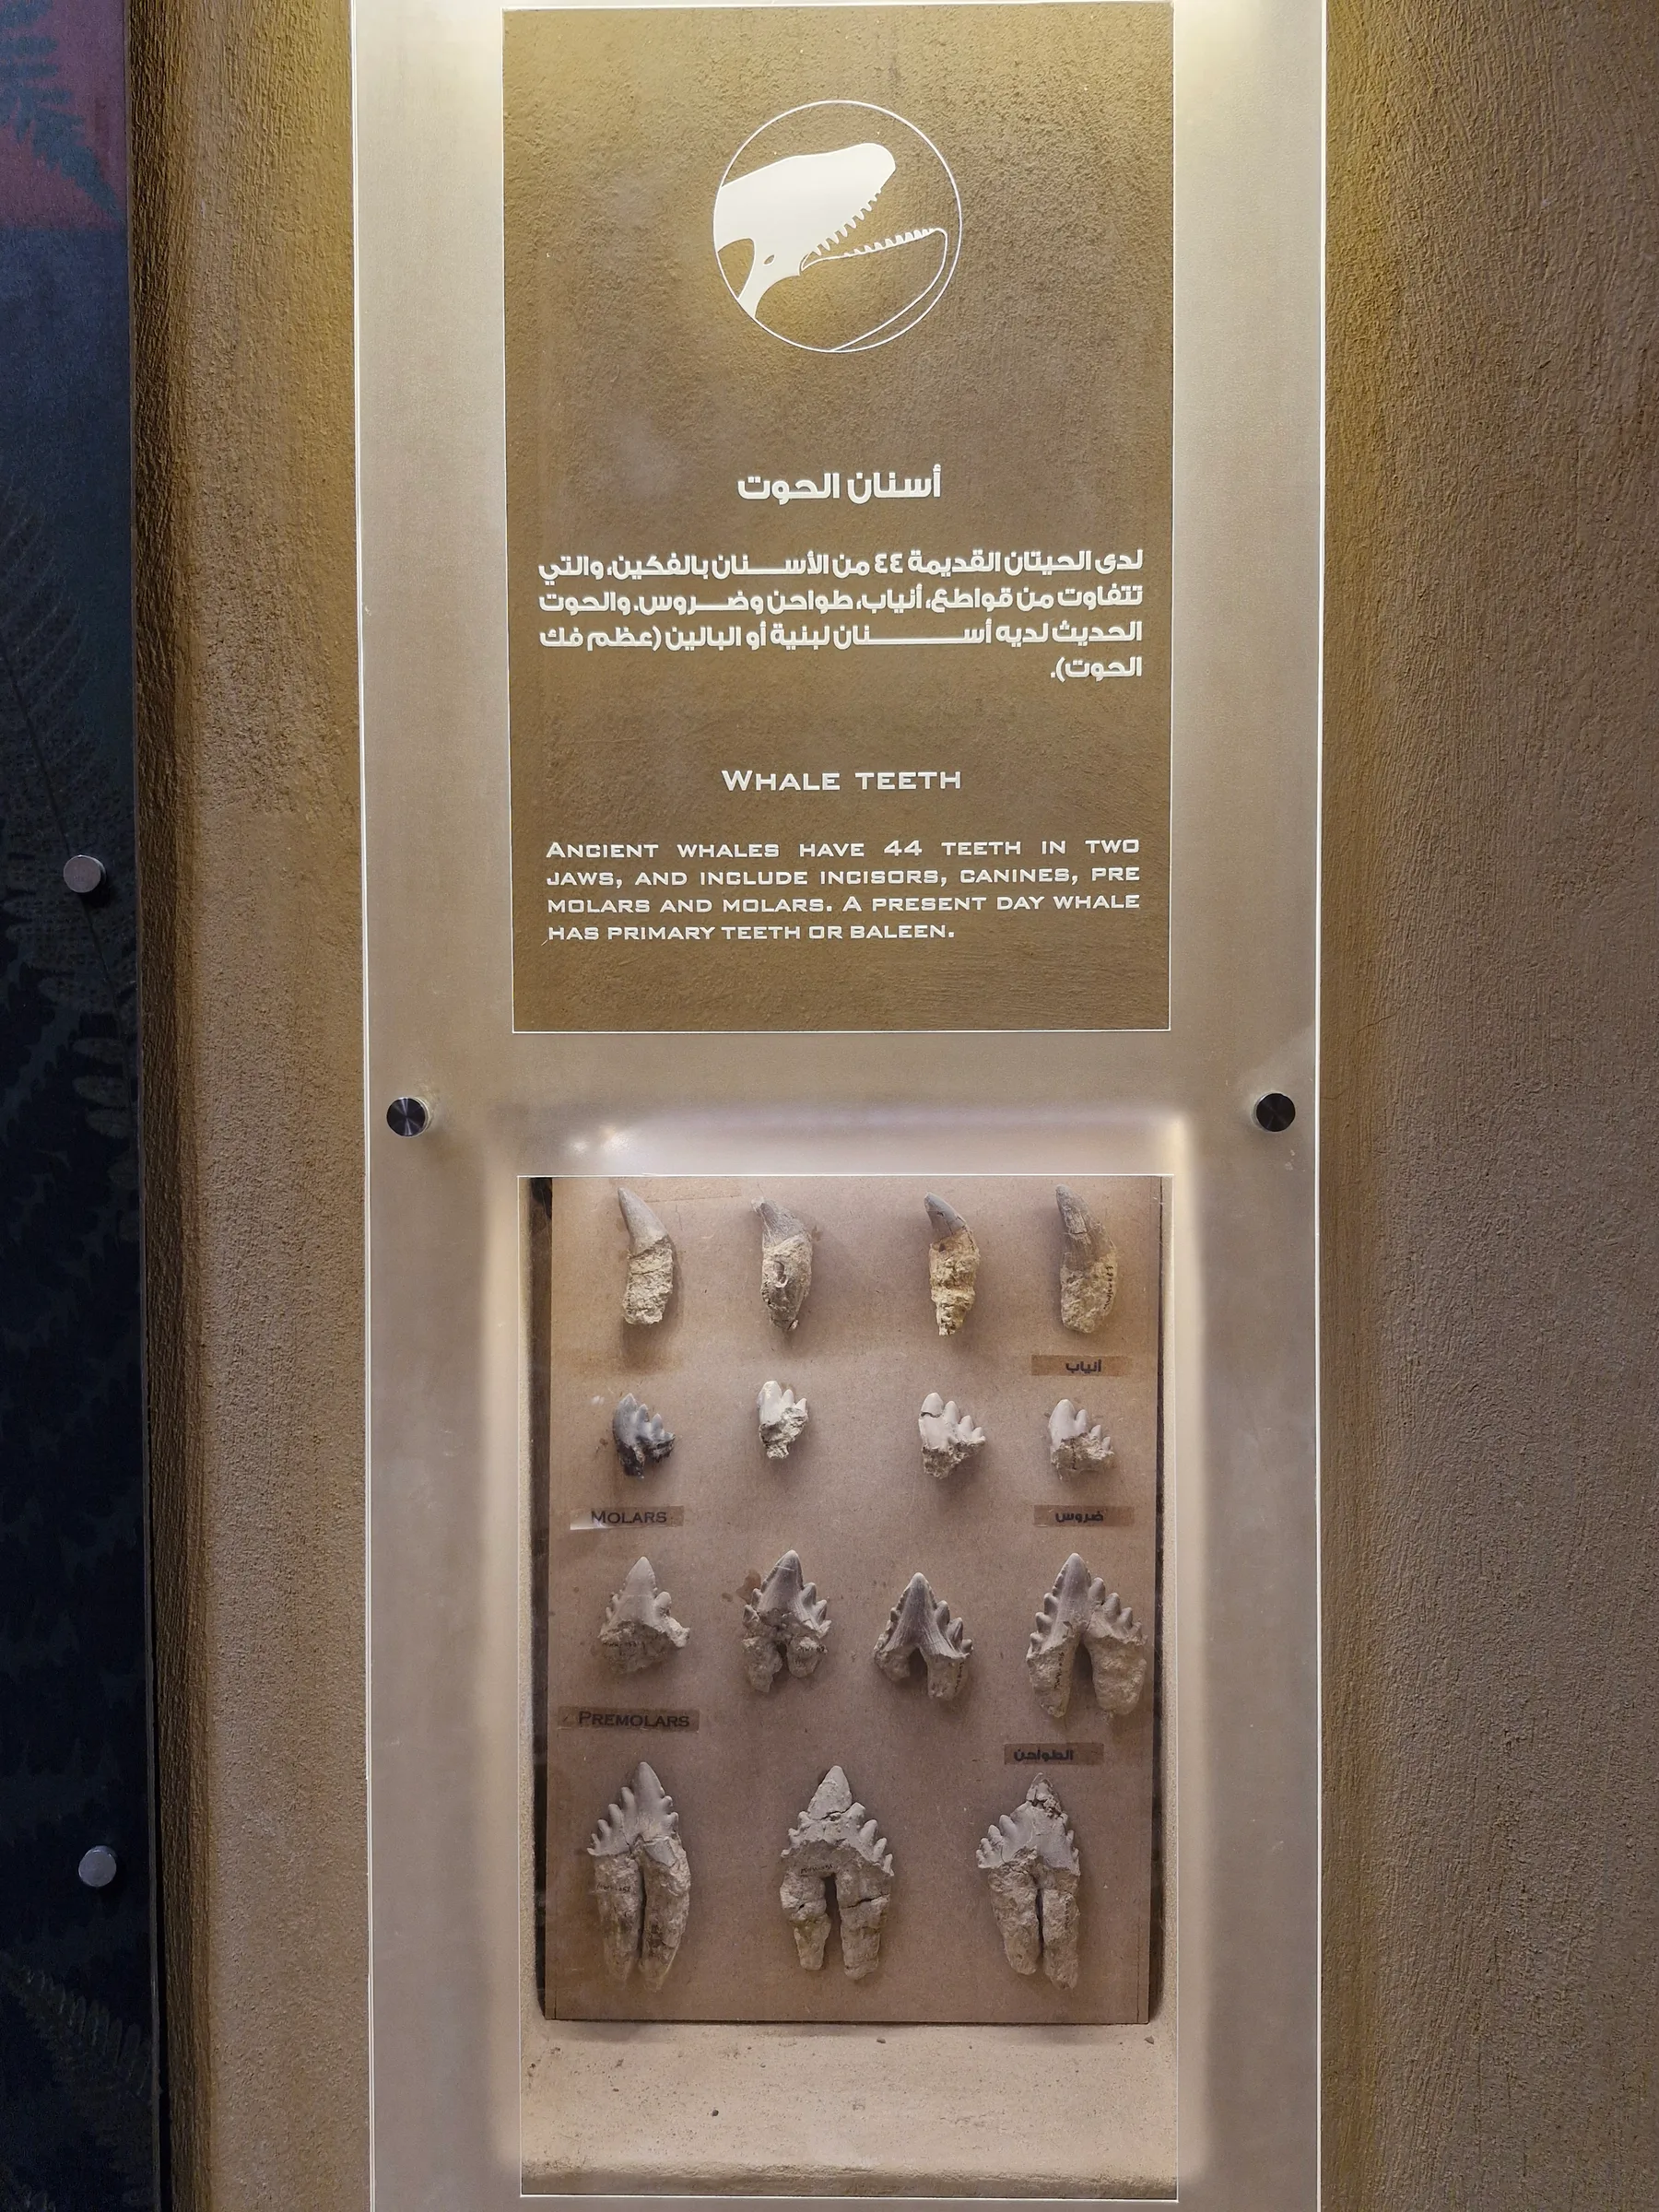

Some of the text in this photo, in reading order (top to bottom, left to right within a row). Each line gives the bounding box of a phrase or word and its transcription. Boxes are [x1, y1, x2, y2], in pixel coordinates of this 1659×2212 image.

[738, 464, 942, 505] أسنان الحوت
[538, 554, 606, 584] والتي
[606, 551, 710, 581] بالفكين،
[832, 553, 871, 578] من
[875, 552, 904, 574] ٤٤
[908, 549, 1002, 577] القديمة
[1005, 549, 1092, 576] الحيتان
[1094, 548, 1145, 575] لدى
[539, 590, 632, 616] والحوت
[767, 589, 854, 615] طواحن
[856, 582, 924, 614] أنياب،
[925, 586, 1014, 613] قواطع،
[1017, 586, 1055, 611] من
[1057, 582, 1144, 610] تتفاوت
[539, 625, 584, 647] فك
[665, 626, 743, 651] البالين
[746, 619, 768, 651] أو
[770, 621, 831, 650] لبنية
[995, 621, 1049, 647] لديه
[1052, 619, 1144, 646] الحديث
[723, 770, 961, 791] WHALE TEETH
[547, 839, 1140, 858] ANCIENT WHALES HAVE 44 TEETH IN TWO
[547, 866, 1141, 889] JAWS, AND INCLUDE INCISORS, CANINES, PRE
[548, 894, 1141, 913] MOLARS AND MOLARS. A PRESENT DAY WHALE
[549, 924, 956, 940] HAS PRIMARY TEETH OR BALEEN.
[591, 1510, 667, 1524] MOLARS
[1055, 1510, 1104, 1524] ضروس
[578, 1710, 690, 1728] PREMOLARS
[1013, 1748, 1074, 1762] الطواحن
